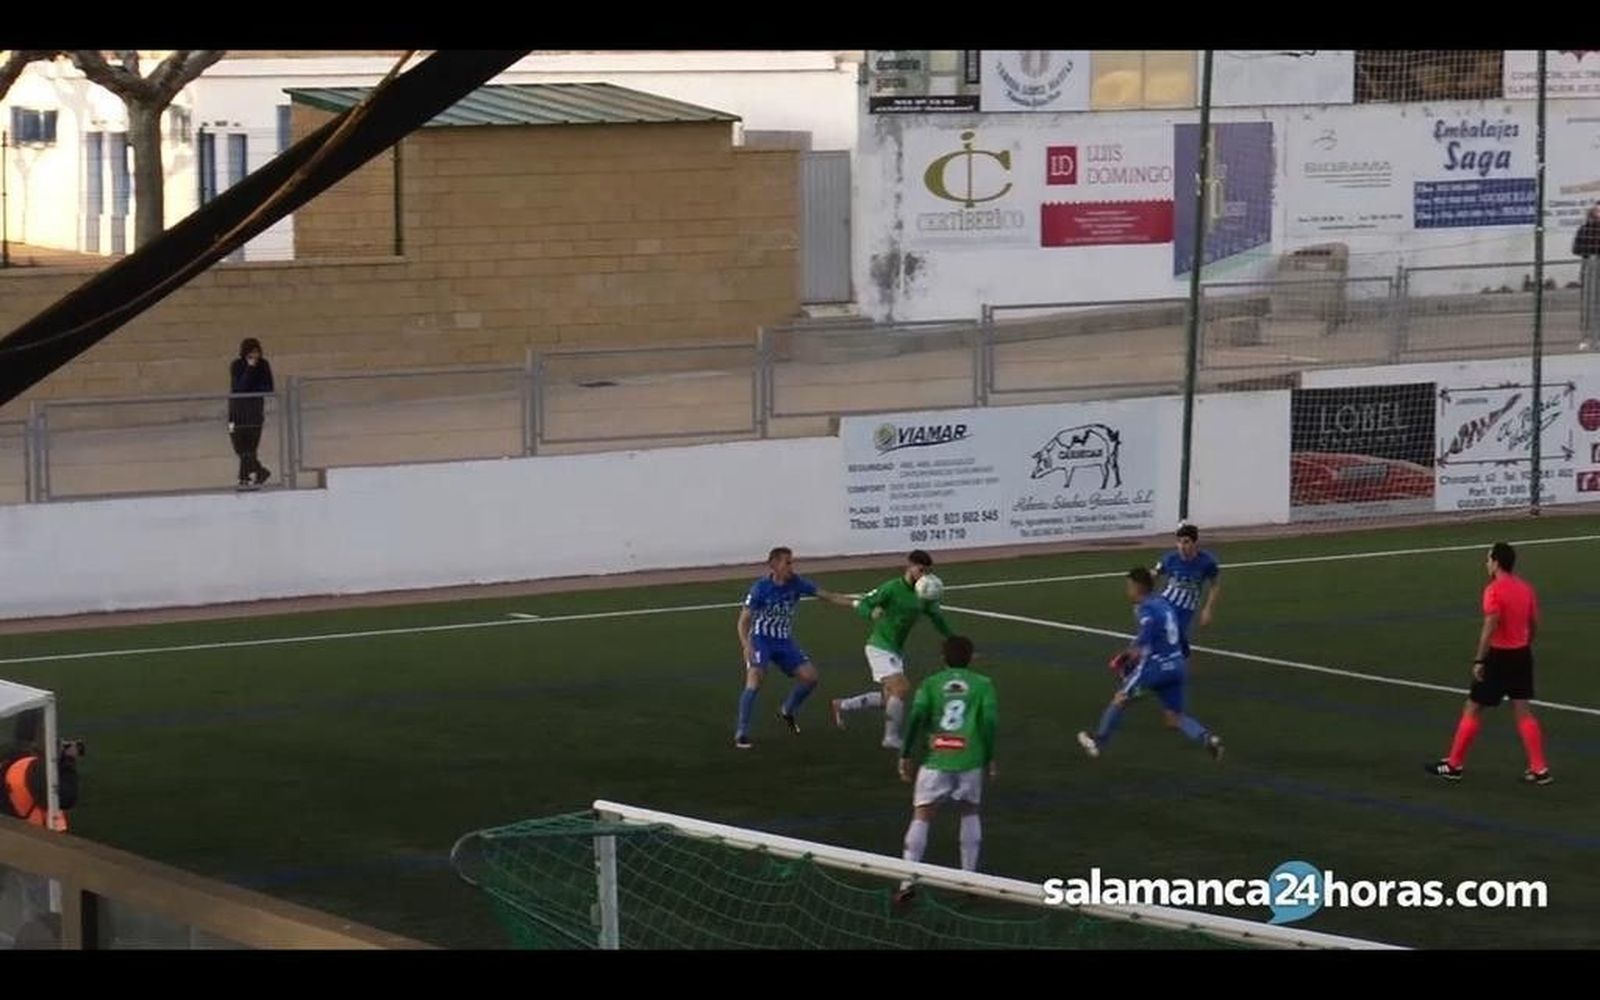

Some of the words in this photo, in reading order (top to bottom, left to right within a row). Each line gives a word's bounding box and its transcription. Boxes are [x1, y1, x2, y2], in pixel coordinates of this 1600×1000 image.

[1433, 119, 1520, 141] Embalajes
[1087, 145, 1123, 162] LUIS
[1444, 141, 1512, 177] Saga
[1087, 166, 1173, 185] DOMINGO
[1320, 402, 1409, 433] LOBEL
[898, 424, 968, 444] VIAMAR
[981, 509, 999, 522] 545
[940, 700, 966, 731] 8
